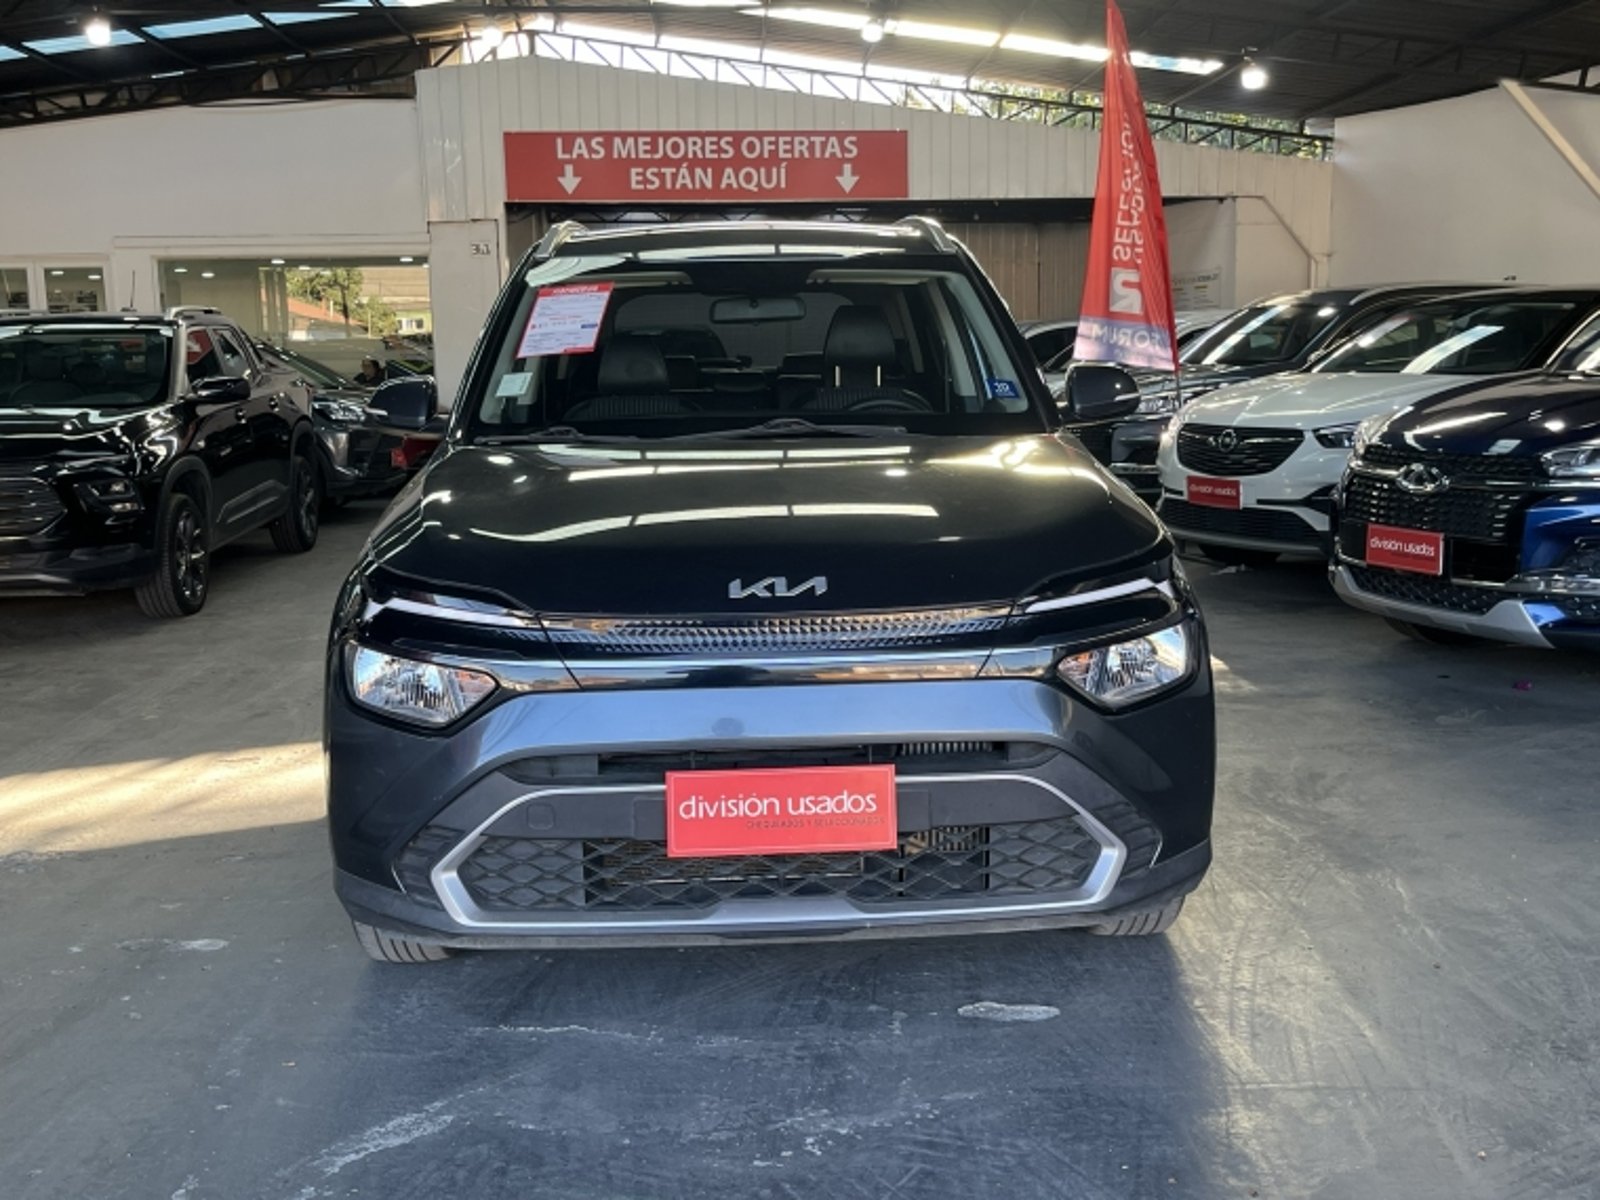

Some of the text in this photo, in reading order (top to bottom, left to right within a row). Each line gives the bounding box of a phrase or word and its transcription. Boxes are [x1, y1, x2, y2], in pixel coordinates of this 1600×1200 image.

[556, 135, 858, 160] LAS MEJORES OFERTAS
[630, 162, 788, 192] ESTÁN AQUÍ
[1369, 535, 1403, 552] división
[1403, 542, 1435, 557] usados
[728, 576, 828, 599] KIA
[679, 789, 878, 820] división usados
